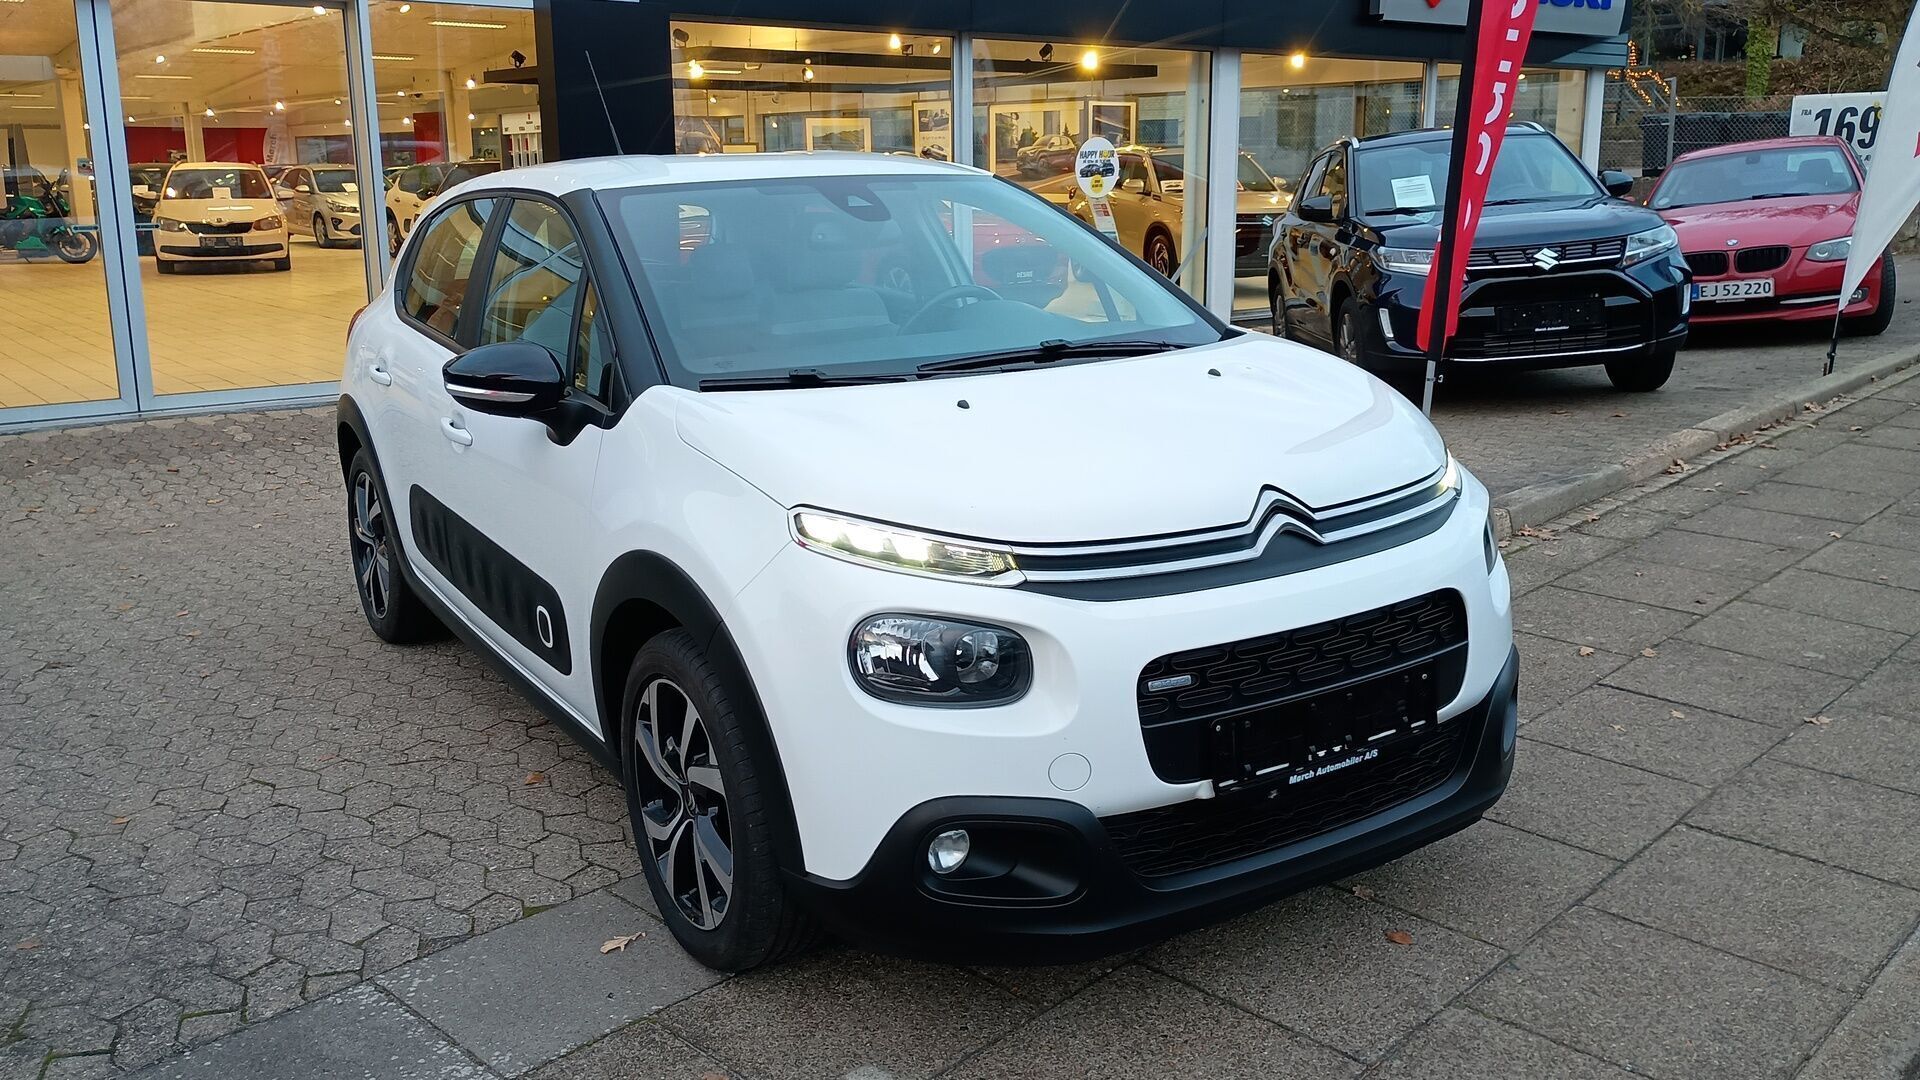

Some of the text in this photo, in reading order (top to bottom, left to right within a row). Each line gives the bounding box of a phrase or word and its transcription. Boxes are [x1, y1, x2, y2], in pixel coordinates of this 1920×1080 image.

[1814, 105, 1881, 149] 169
[1079, 150, 1099, 159] HAPPY
[1700, 281, 1771, 298] EJ 52 220
[1315, 755, 1364, 776] Automobiler
[1363, 748, 1379, 761] A/S
